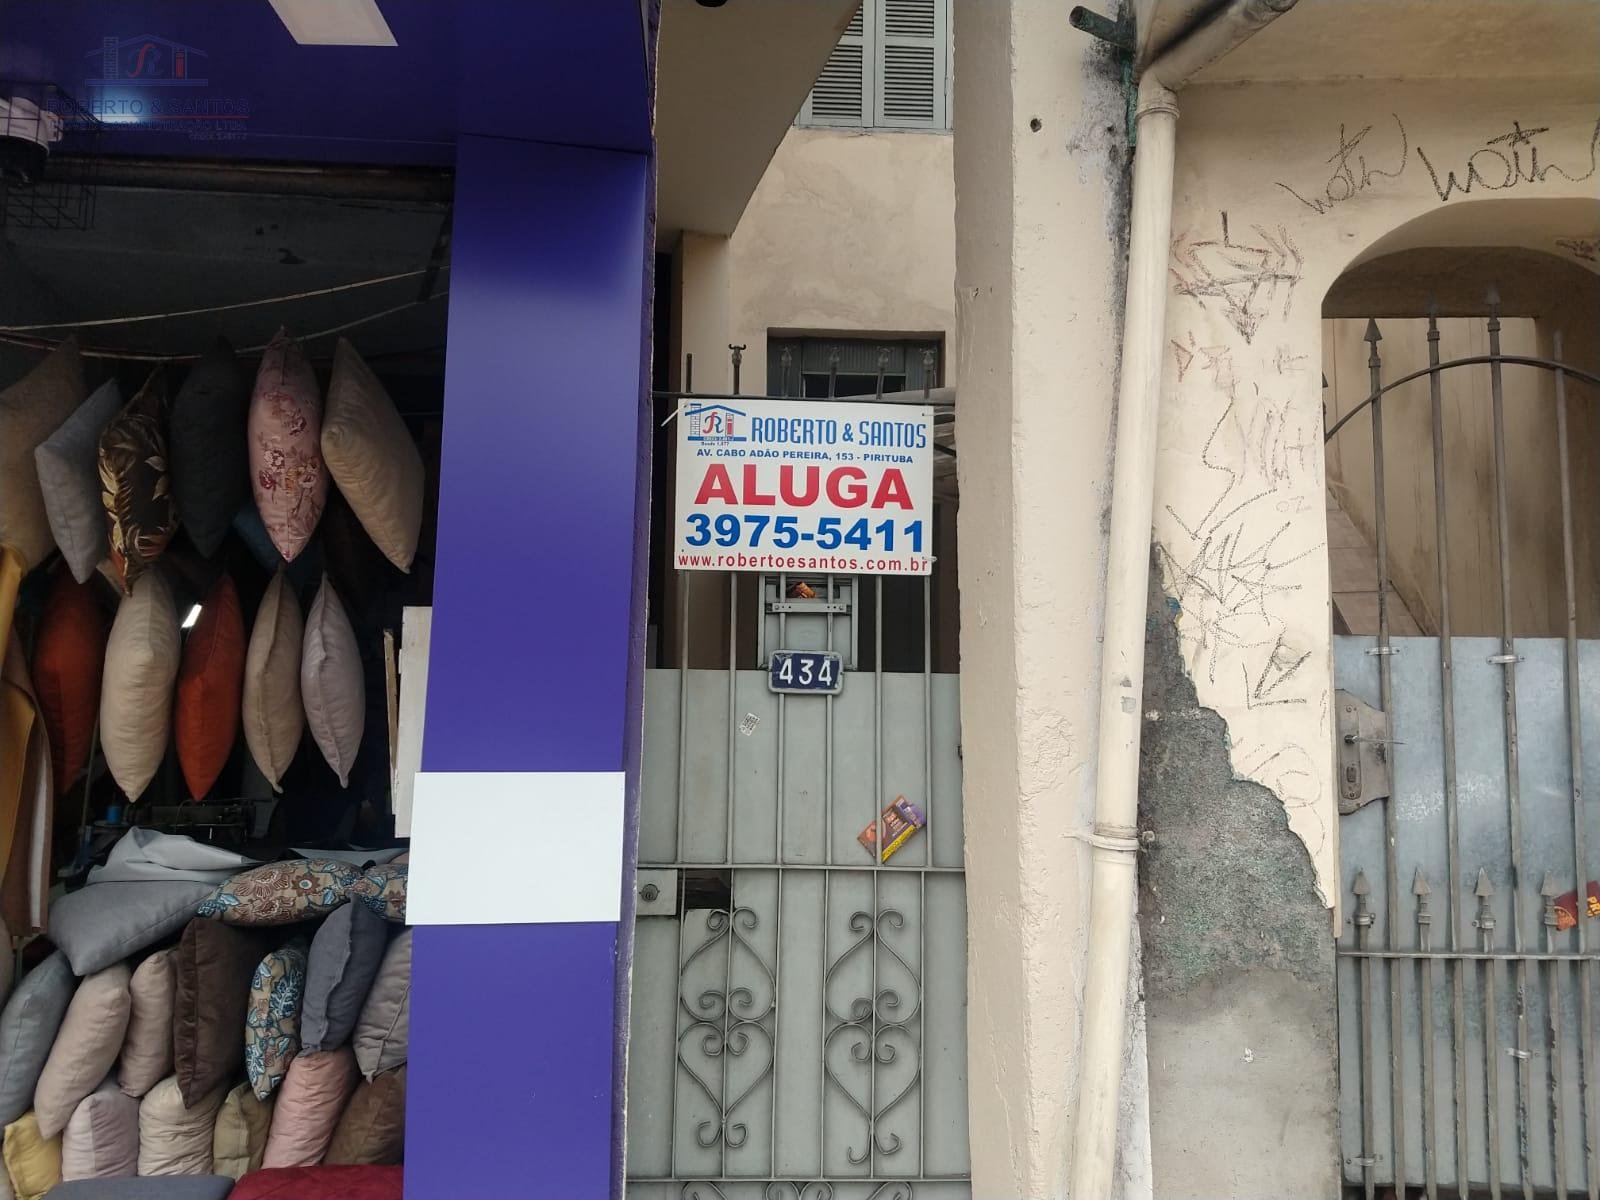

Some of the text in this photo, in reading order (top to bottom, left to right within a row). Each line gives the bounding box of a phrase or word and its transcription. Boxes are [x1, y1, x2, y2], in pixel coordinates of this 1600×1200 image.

[752, 417, 927, 448] ROBERTO & SANTOS
[696, 448, 713, 458] AV.
[716, 448, 746, 458] CABO
[749, 448, 779, 459] ADÃO
[782, 451, 832, 462] PEREIRA,
[835, 452, 855, 462] 153
[863, 453, 914, 464] PIRITUBA
[694, 463, 914, 510] ALUGA
[685, 513, 922, 553] 3975-5411
[678, 552, 928, 572] www.robertoesantos.com.br
[779, 658, 833, 686] 434
